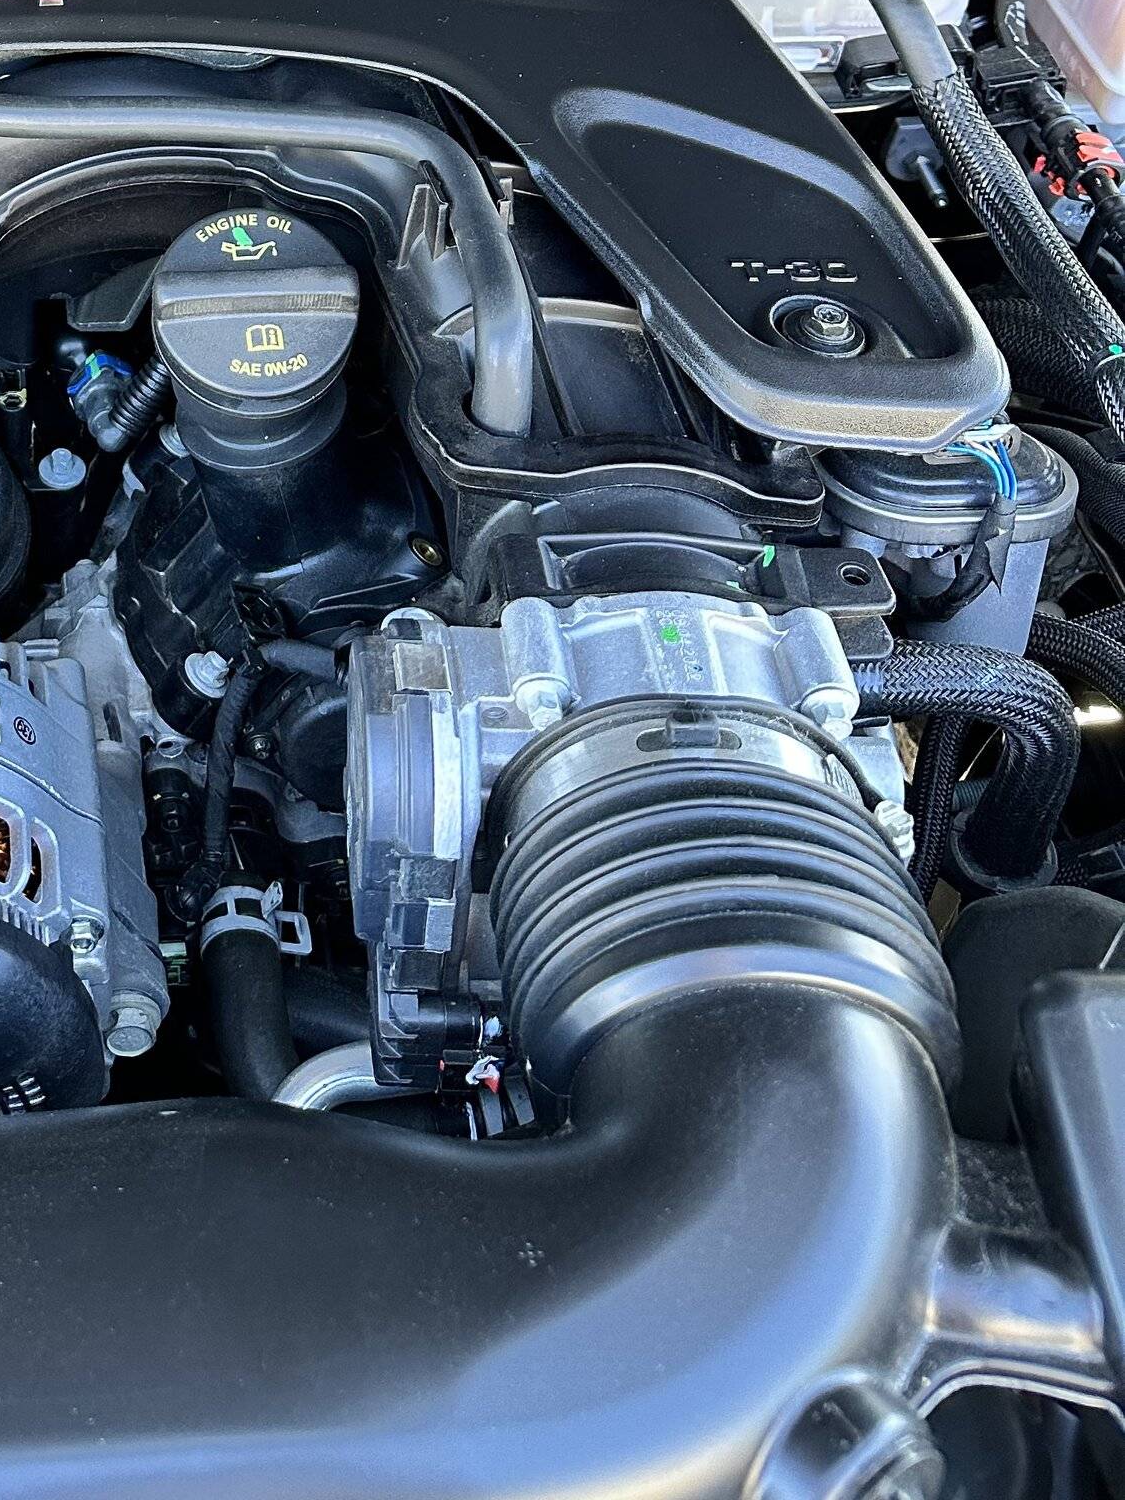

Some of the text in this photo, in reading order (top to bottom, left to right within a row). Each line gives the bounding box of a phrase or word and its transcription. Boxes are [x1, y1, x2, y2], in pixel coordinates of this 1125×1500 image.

[195, 214, 292, 243] ENGINE OIL
[230, 354, 308, 377] SAE 0W-20
